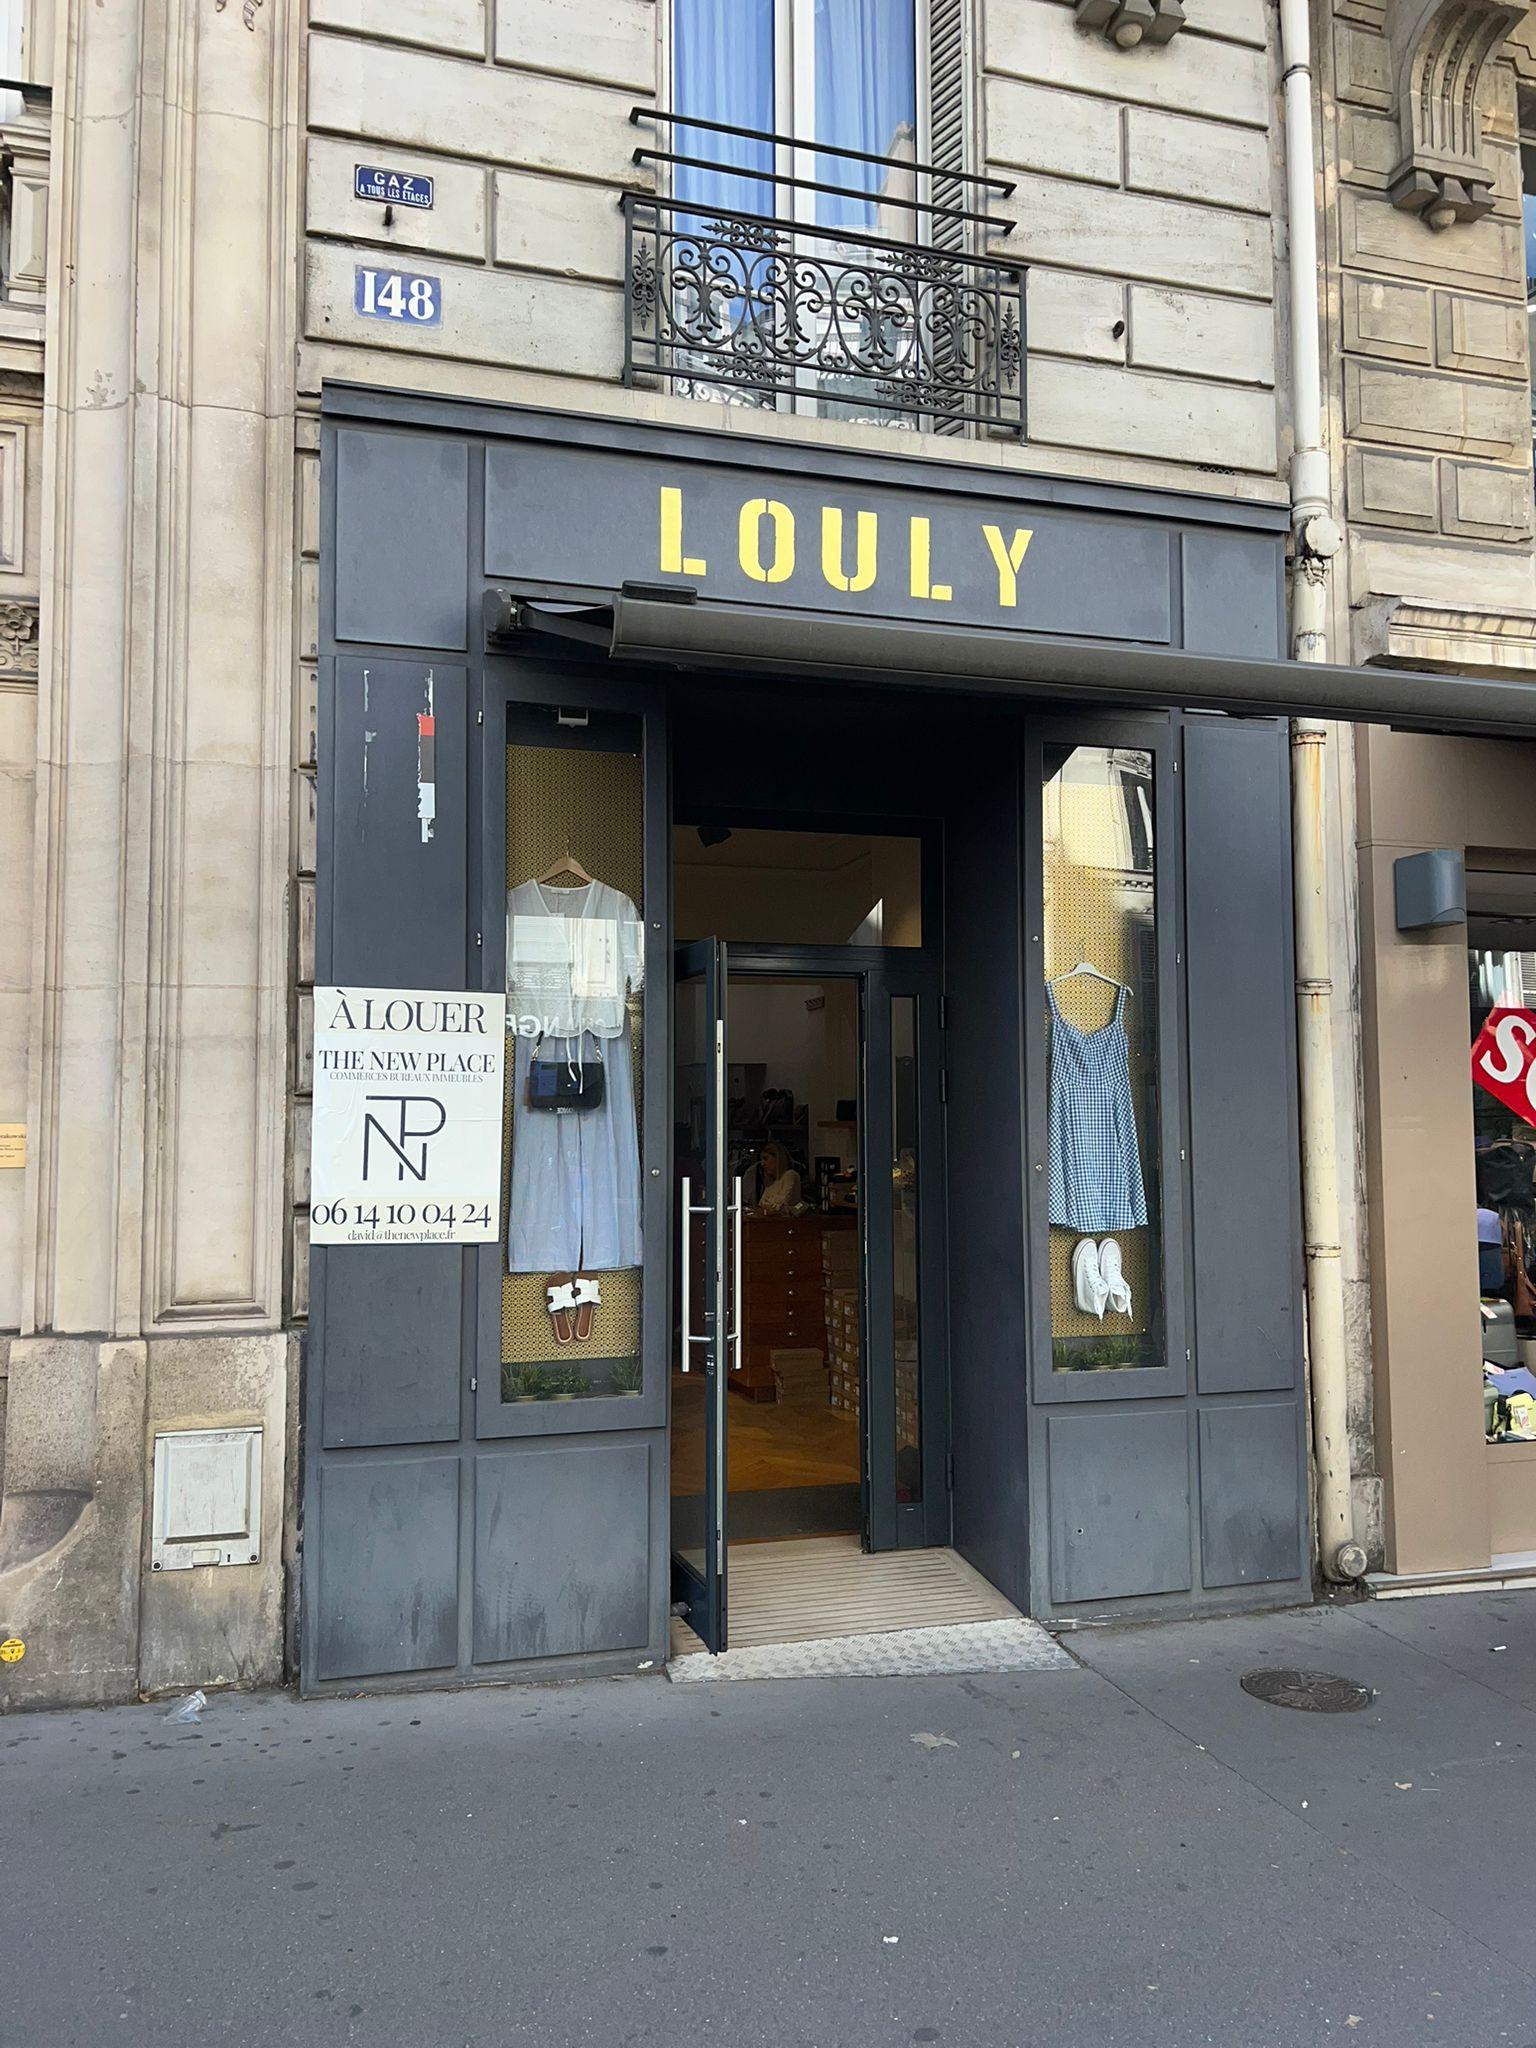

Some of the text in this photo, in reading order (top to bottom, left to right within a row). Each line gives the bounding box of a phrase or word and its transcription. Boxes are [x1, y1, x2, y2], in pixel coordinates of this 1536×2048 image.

[367, 184, 385, 196] TOUS
[388, 188, 400, 199] LES
[374, 172, 414, 191] GAZ
[362, 270, 435, 320] 148
[660, 486, 1034, 607] LOULY
[329, 989, 487, 1034] À LOUER
[319, 1050, 495, 1074] THE NEW PLACE
[330, 1072, 484, 1084] COMMERCES BUREAUX IMMEUBLES
[1480, 1015, 1536, 1112] S
[312, 1197, 491, 1229] 06 14 10 04 24
